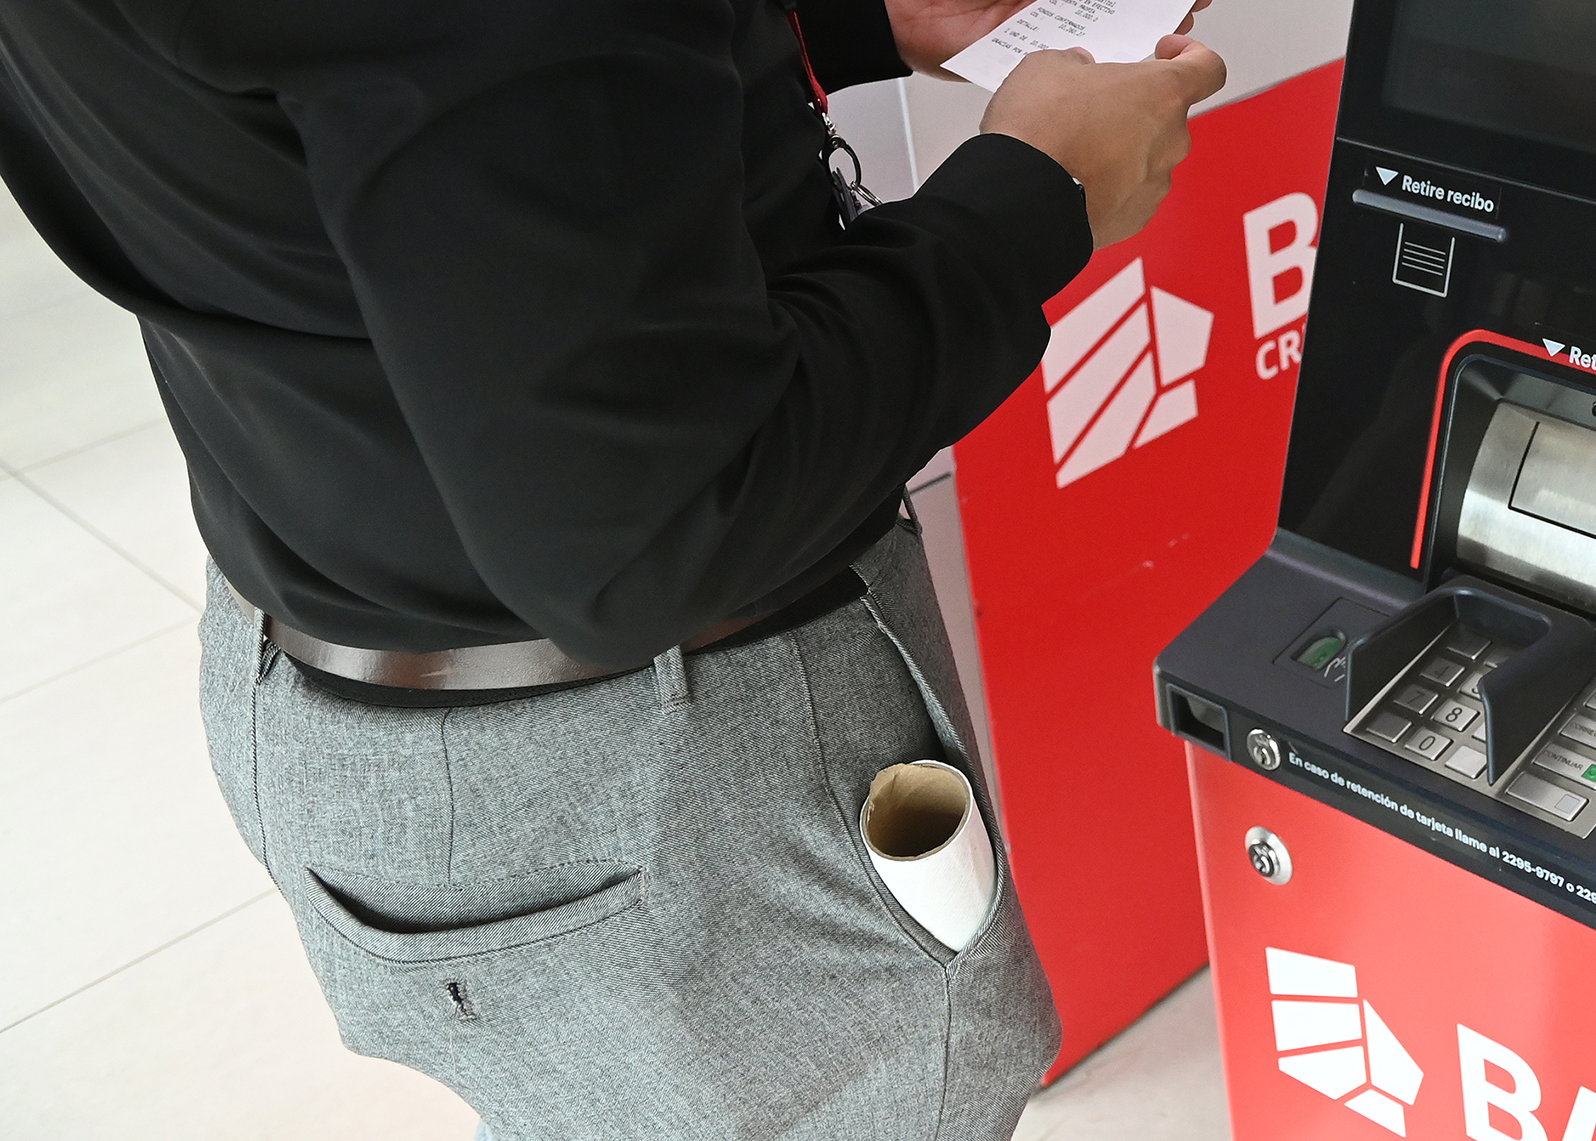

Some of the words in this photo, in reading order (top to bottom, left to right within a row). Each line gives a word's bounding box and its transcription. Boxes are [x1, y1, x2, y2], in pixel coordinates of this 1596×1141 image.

[1401, 174, 1445, 201] Retire
[1447, 188, 1495, 213] recibo
[1445, 707, 1463, 722] 8
[1418, 735, 1436, 751] 0
[1544, 750, 1584, 770] CONTINUAR
[1288, 752, 1303, 768] En
[1304, 762, 1330, 780] caso
[1330, 772, 1345, 787] de
[1346, 780, 1399, 811] retención
[1399, 804, 1415, 819] de
[1416, 812, 1454, 838] tarjeta
[1454, 827, 1488, 853] llame
[1489, 846, 1500, 859] al
[1502, 851, 1565, 888] 2295-9797
[1566, 882, 1575, 893] o
